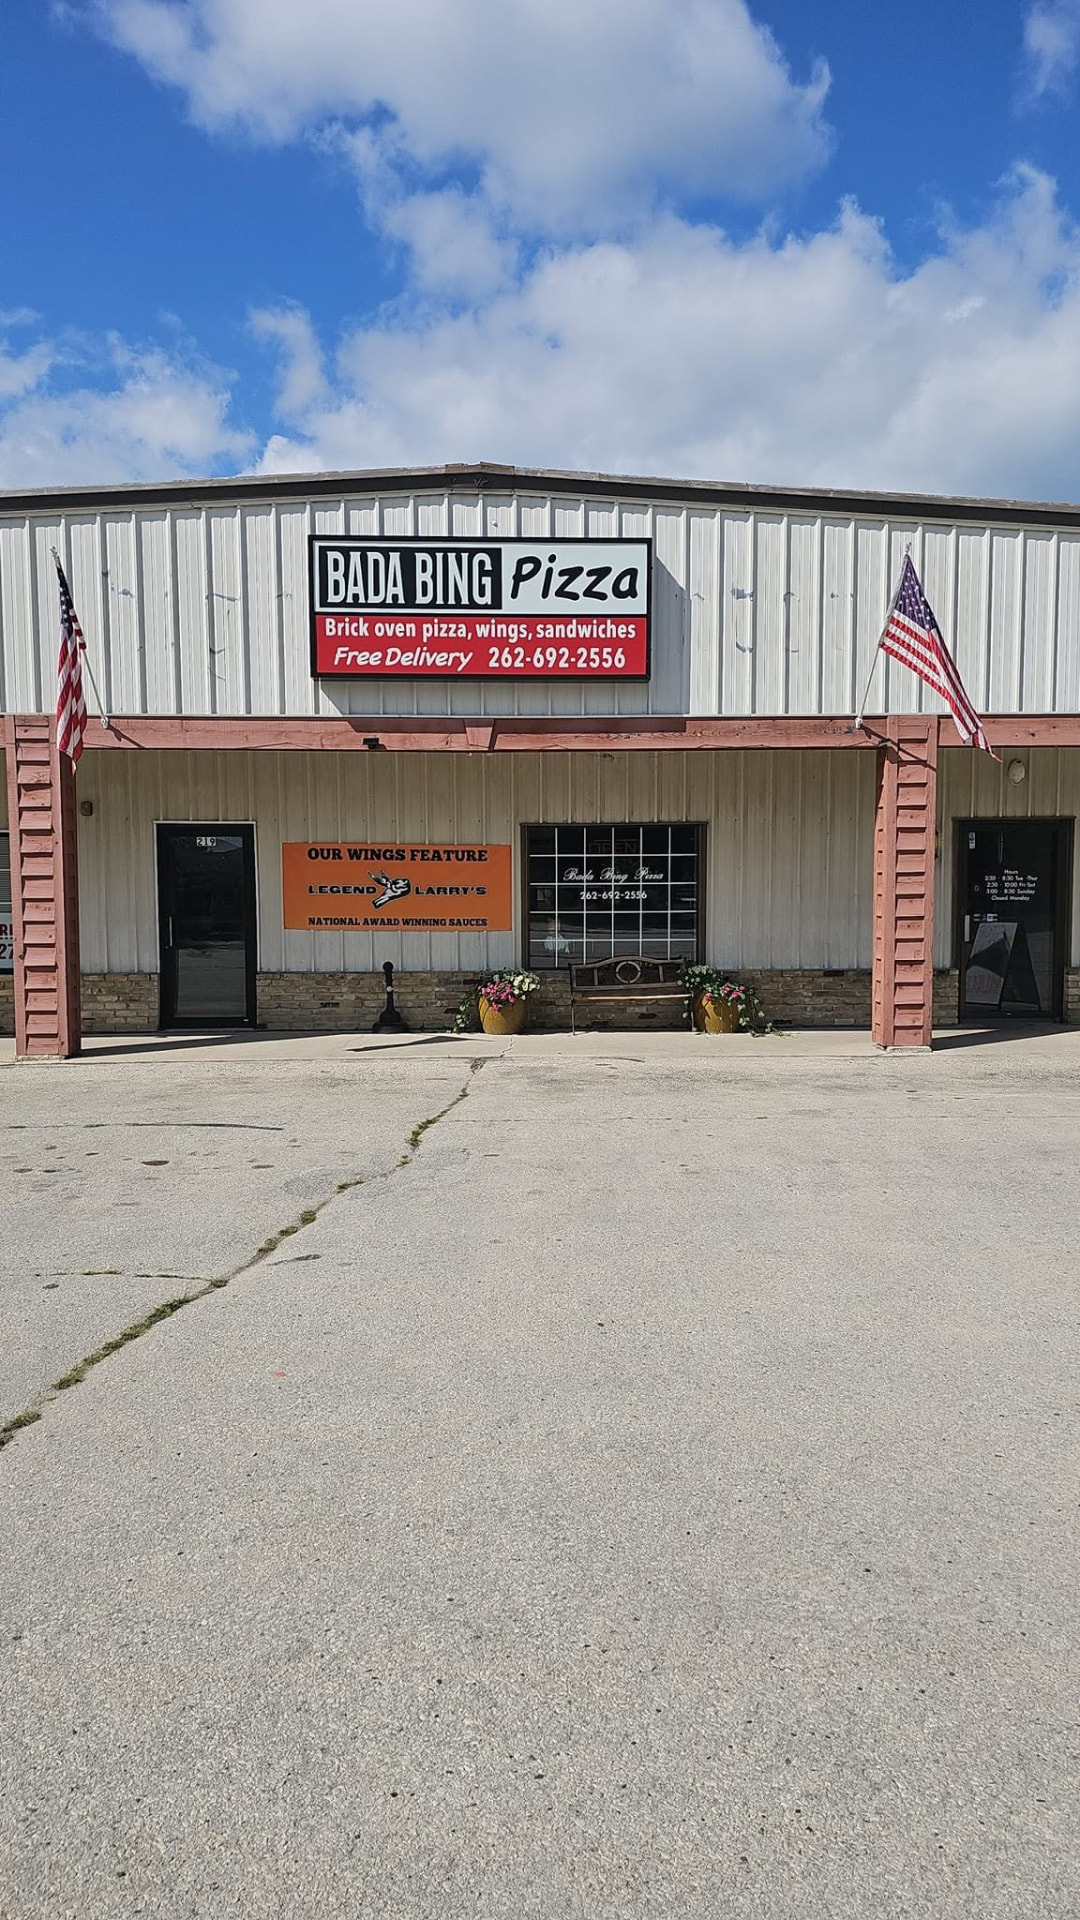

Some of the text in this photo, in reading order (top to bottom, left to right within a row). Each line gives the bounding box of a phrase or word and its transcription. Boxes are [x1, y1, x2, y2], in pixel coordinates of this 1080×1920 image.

[326, 550, 639, 605] BADA BING Pizza
[325, 617, 636, 643] Brick oven pizza, wings, sandwiches
[333, 646, 626, 672] Free Delivery 262-692-2556
[197, 837, 215, 846] 219
[307, 848, 488, 862] OUR WINGS FEATURE
[563, 866, 663, 884] Bada Bing Pizza
[308, 885, 487, 895] LEGEND LARRY'S
[579, 890, 648, 900] 262-692-2556
[308, 917, 487, 927] NATIONAL AWARD WINNING SAUCES
